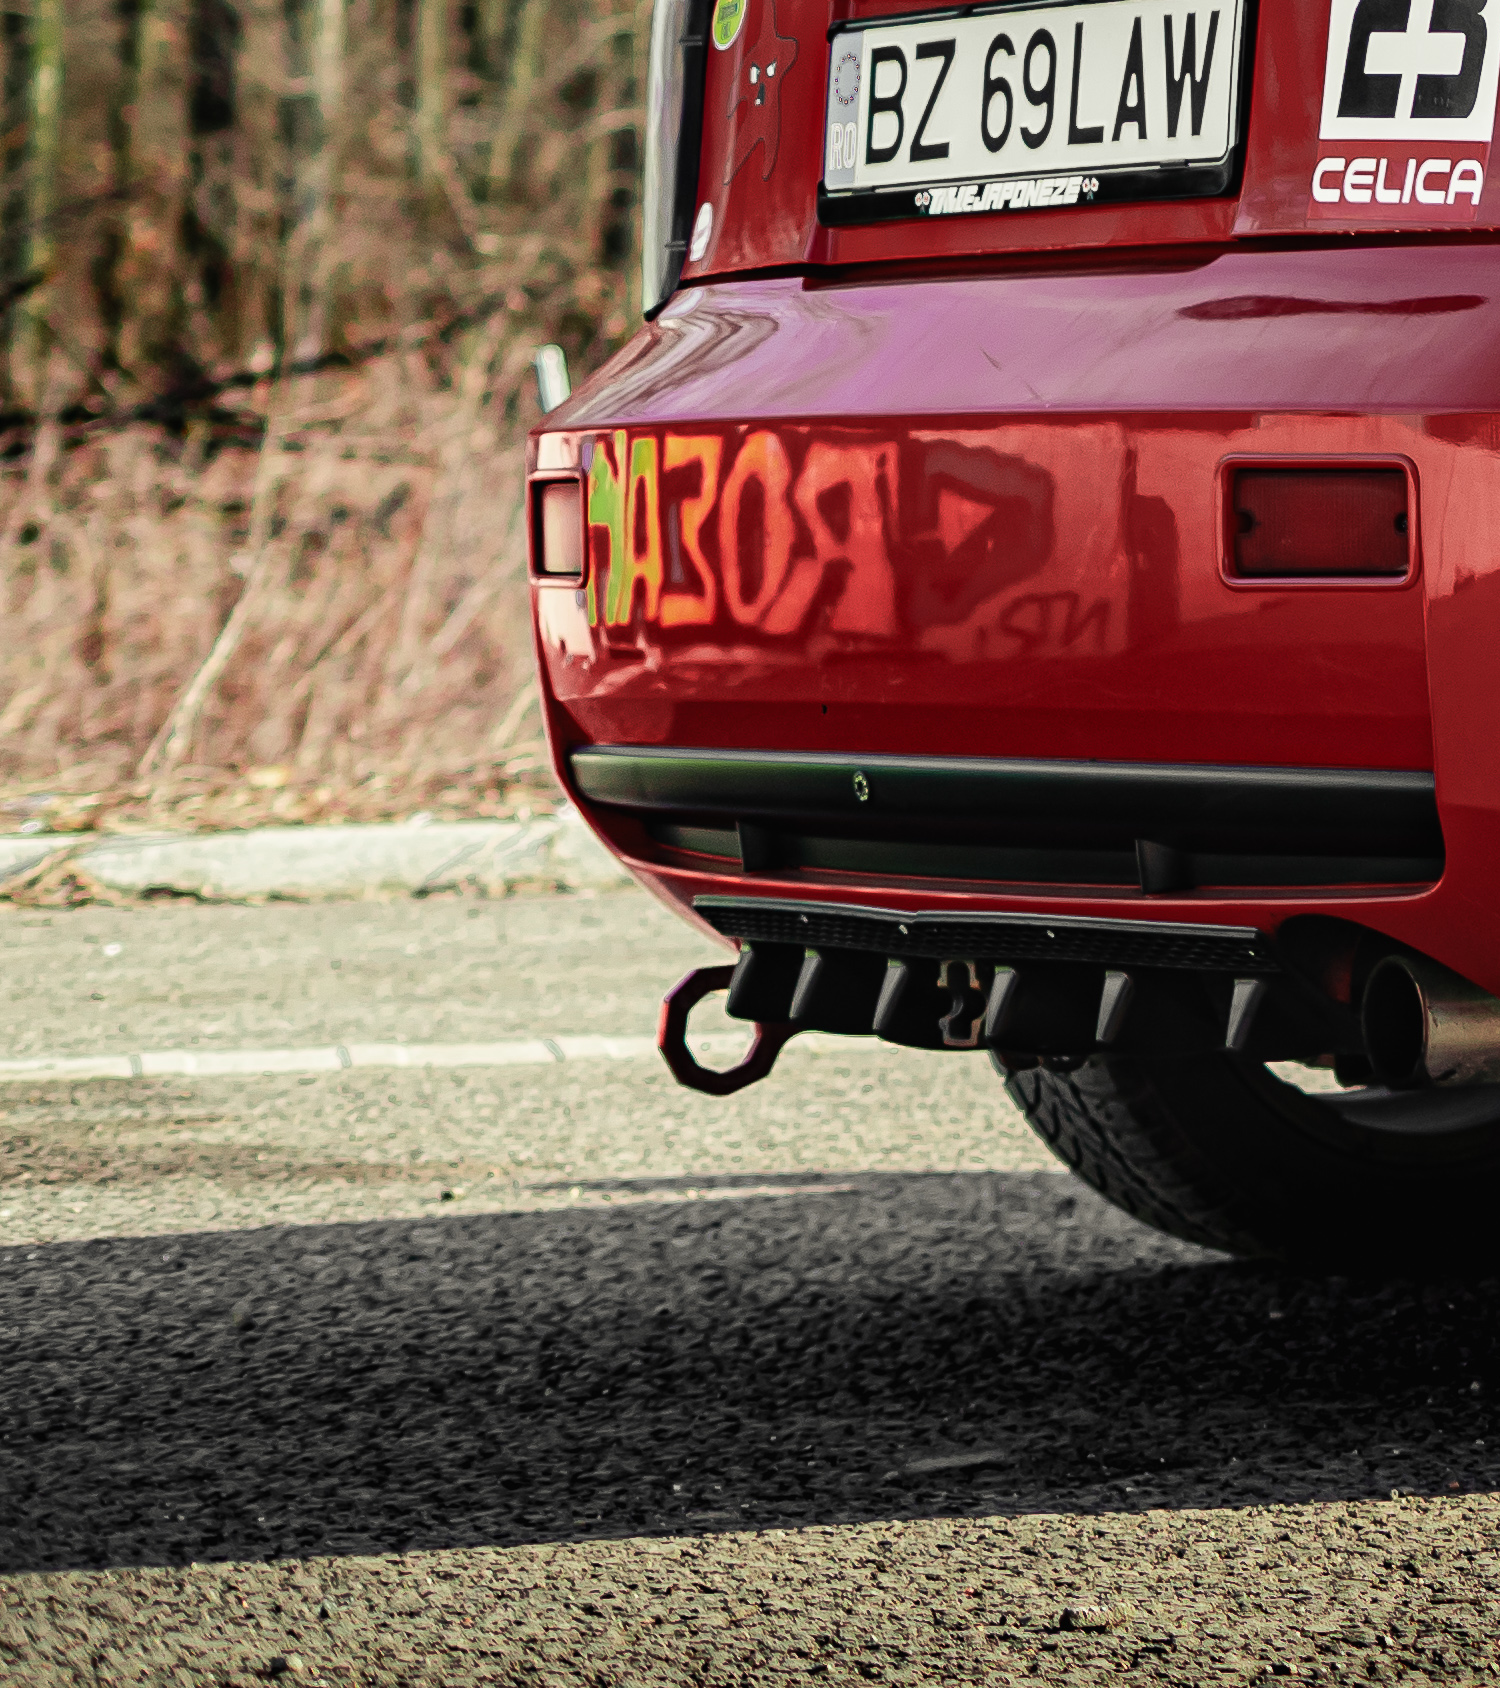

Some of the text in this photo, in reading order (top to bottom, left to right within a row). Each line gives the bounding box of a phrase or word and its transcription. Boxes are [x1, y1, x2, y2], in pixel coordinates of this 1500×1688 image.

[865, 38, 957, 165] BZ
[829, 121, 858, 171] RO
[1311, 157, 1485, 206] CELICA
